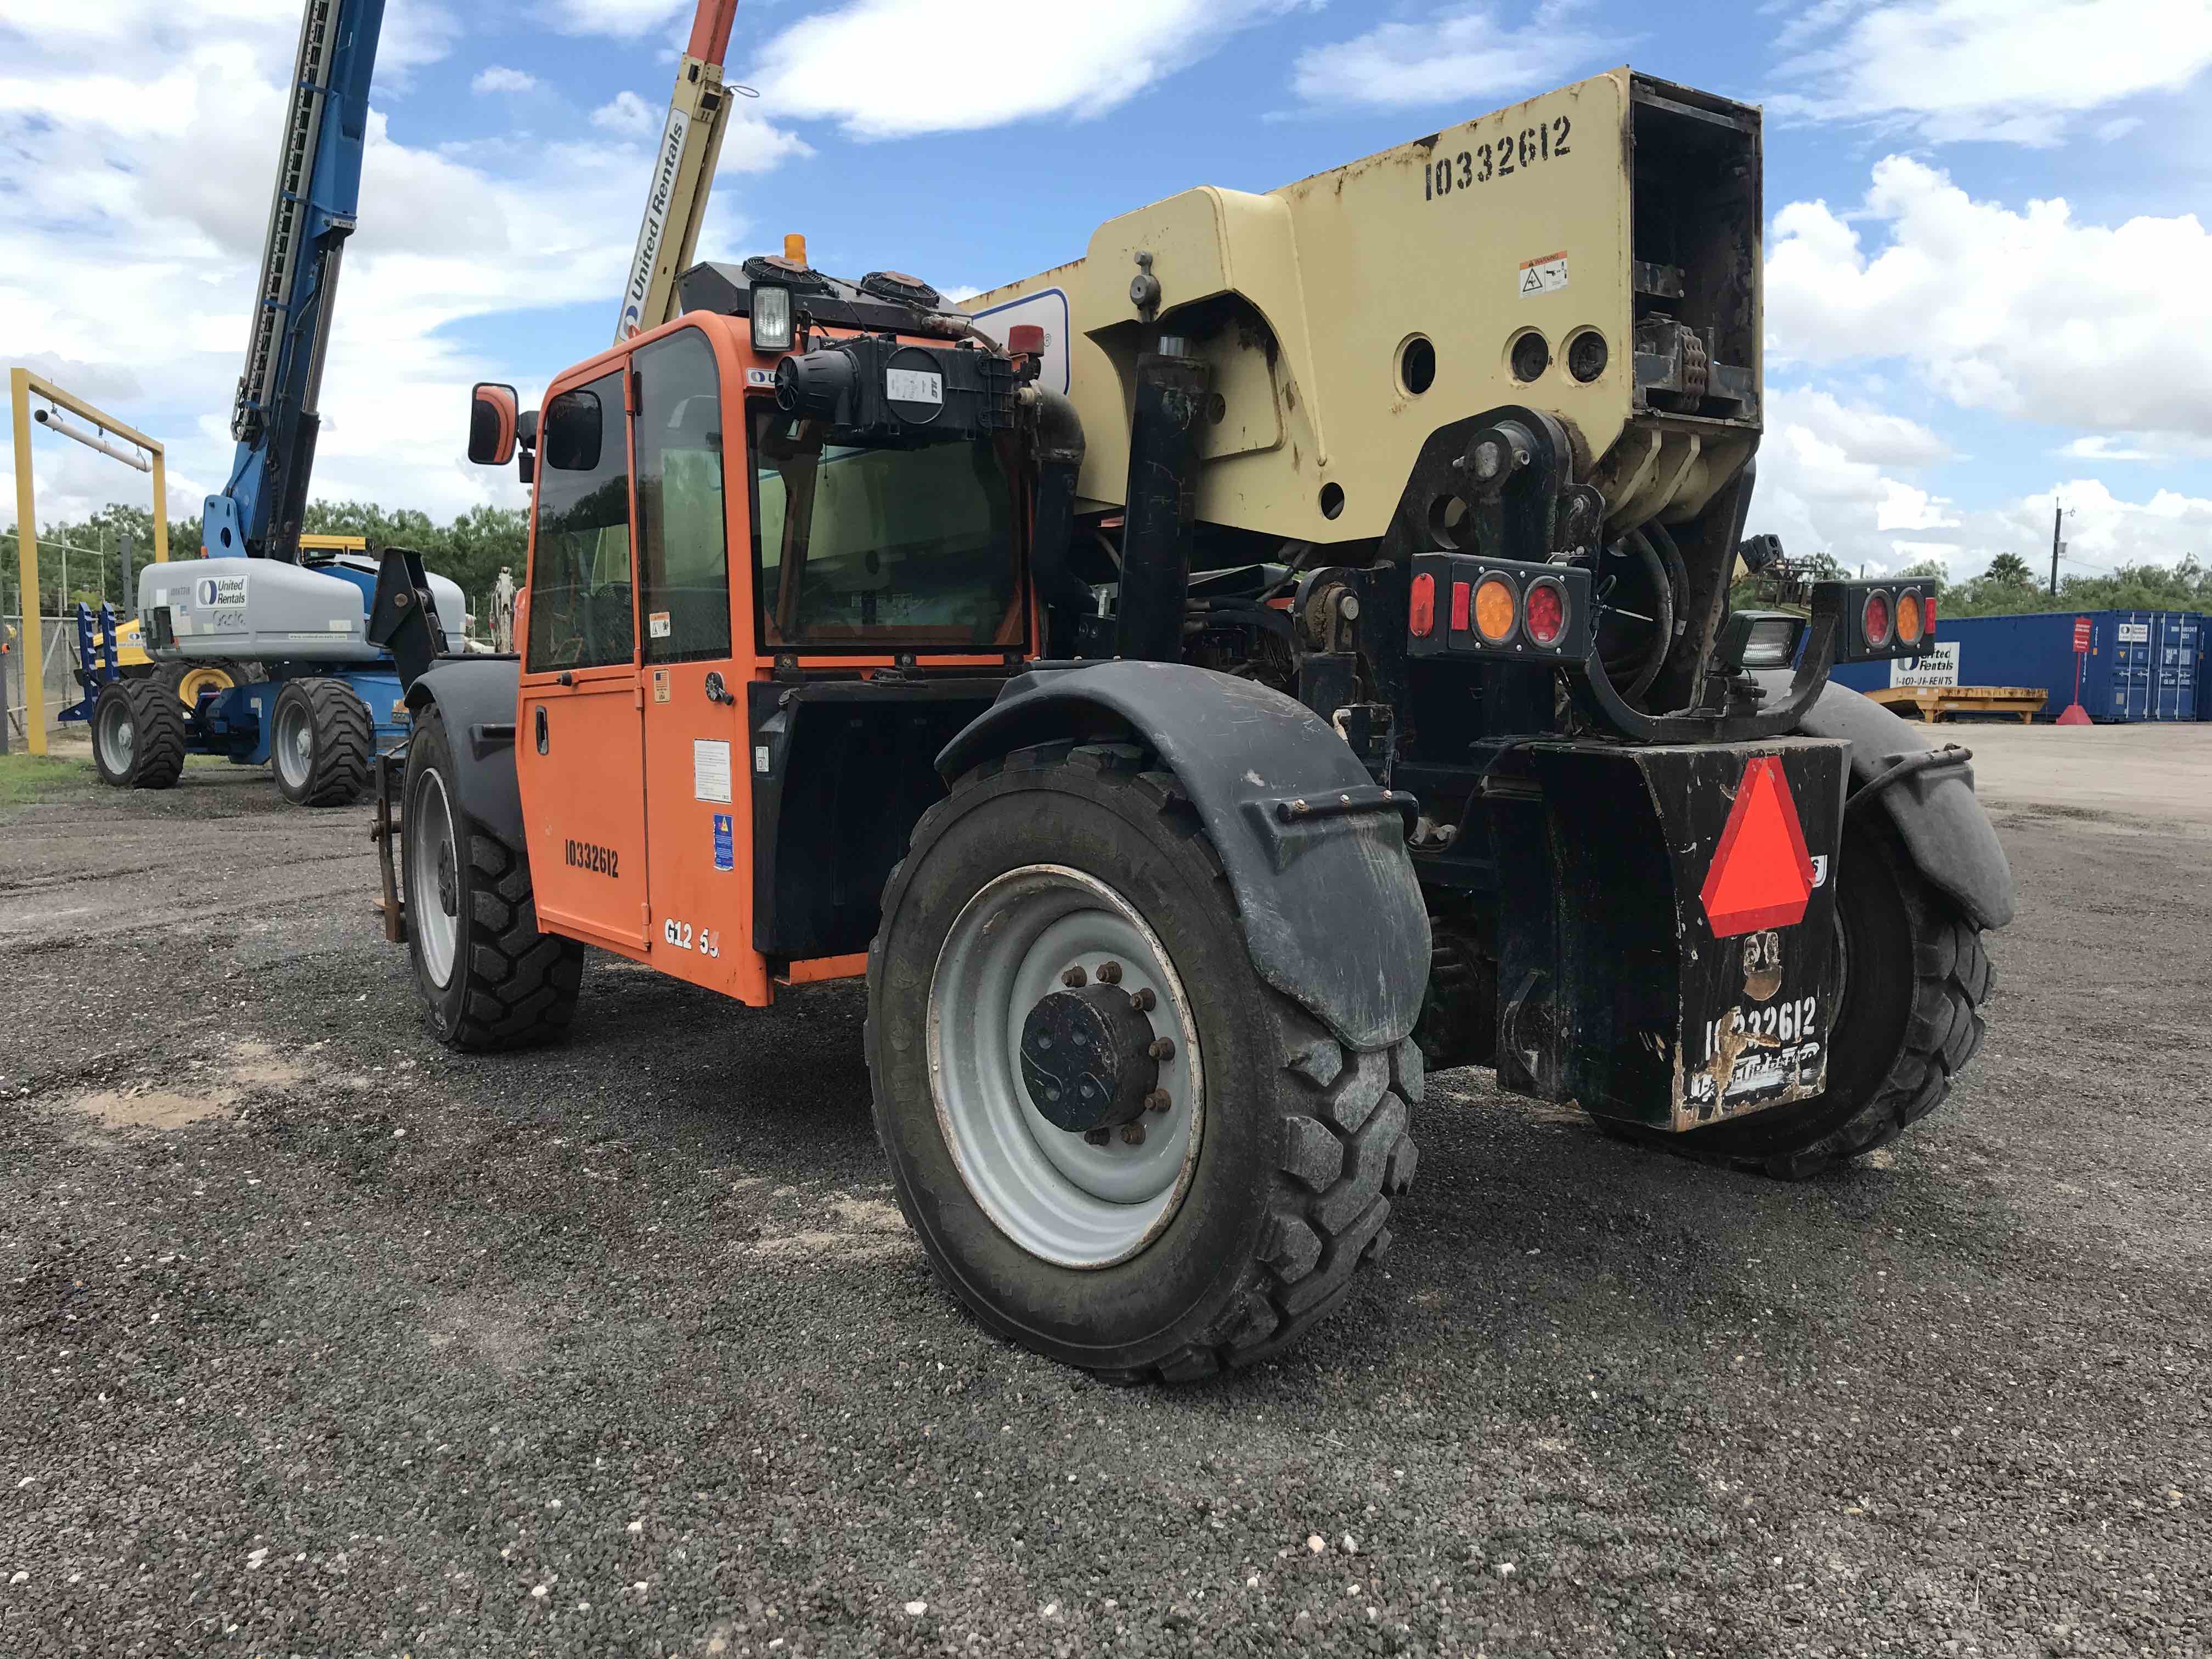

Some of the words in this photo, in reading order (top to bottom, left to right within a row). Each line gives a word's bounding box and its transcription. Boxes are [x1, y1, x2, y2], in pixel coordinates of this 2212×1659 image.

[1426, 116, 1571, 201] 10332612
[631, 217, 659, 302] United
[652, 122, 682, 216] Rentals
[217, 592, 245, 604] Rentals
[218, 579, 244, 591] United
[1920, 659, 1954, 671] Rentals
[566, 838, 619, 878] 10332612
[665, 918, 692, 950] G12
